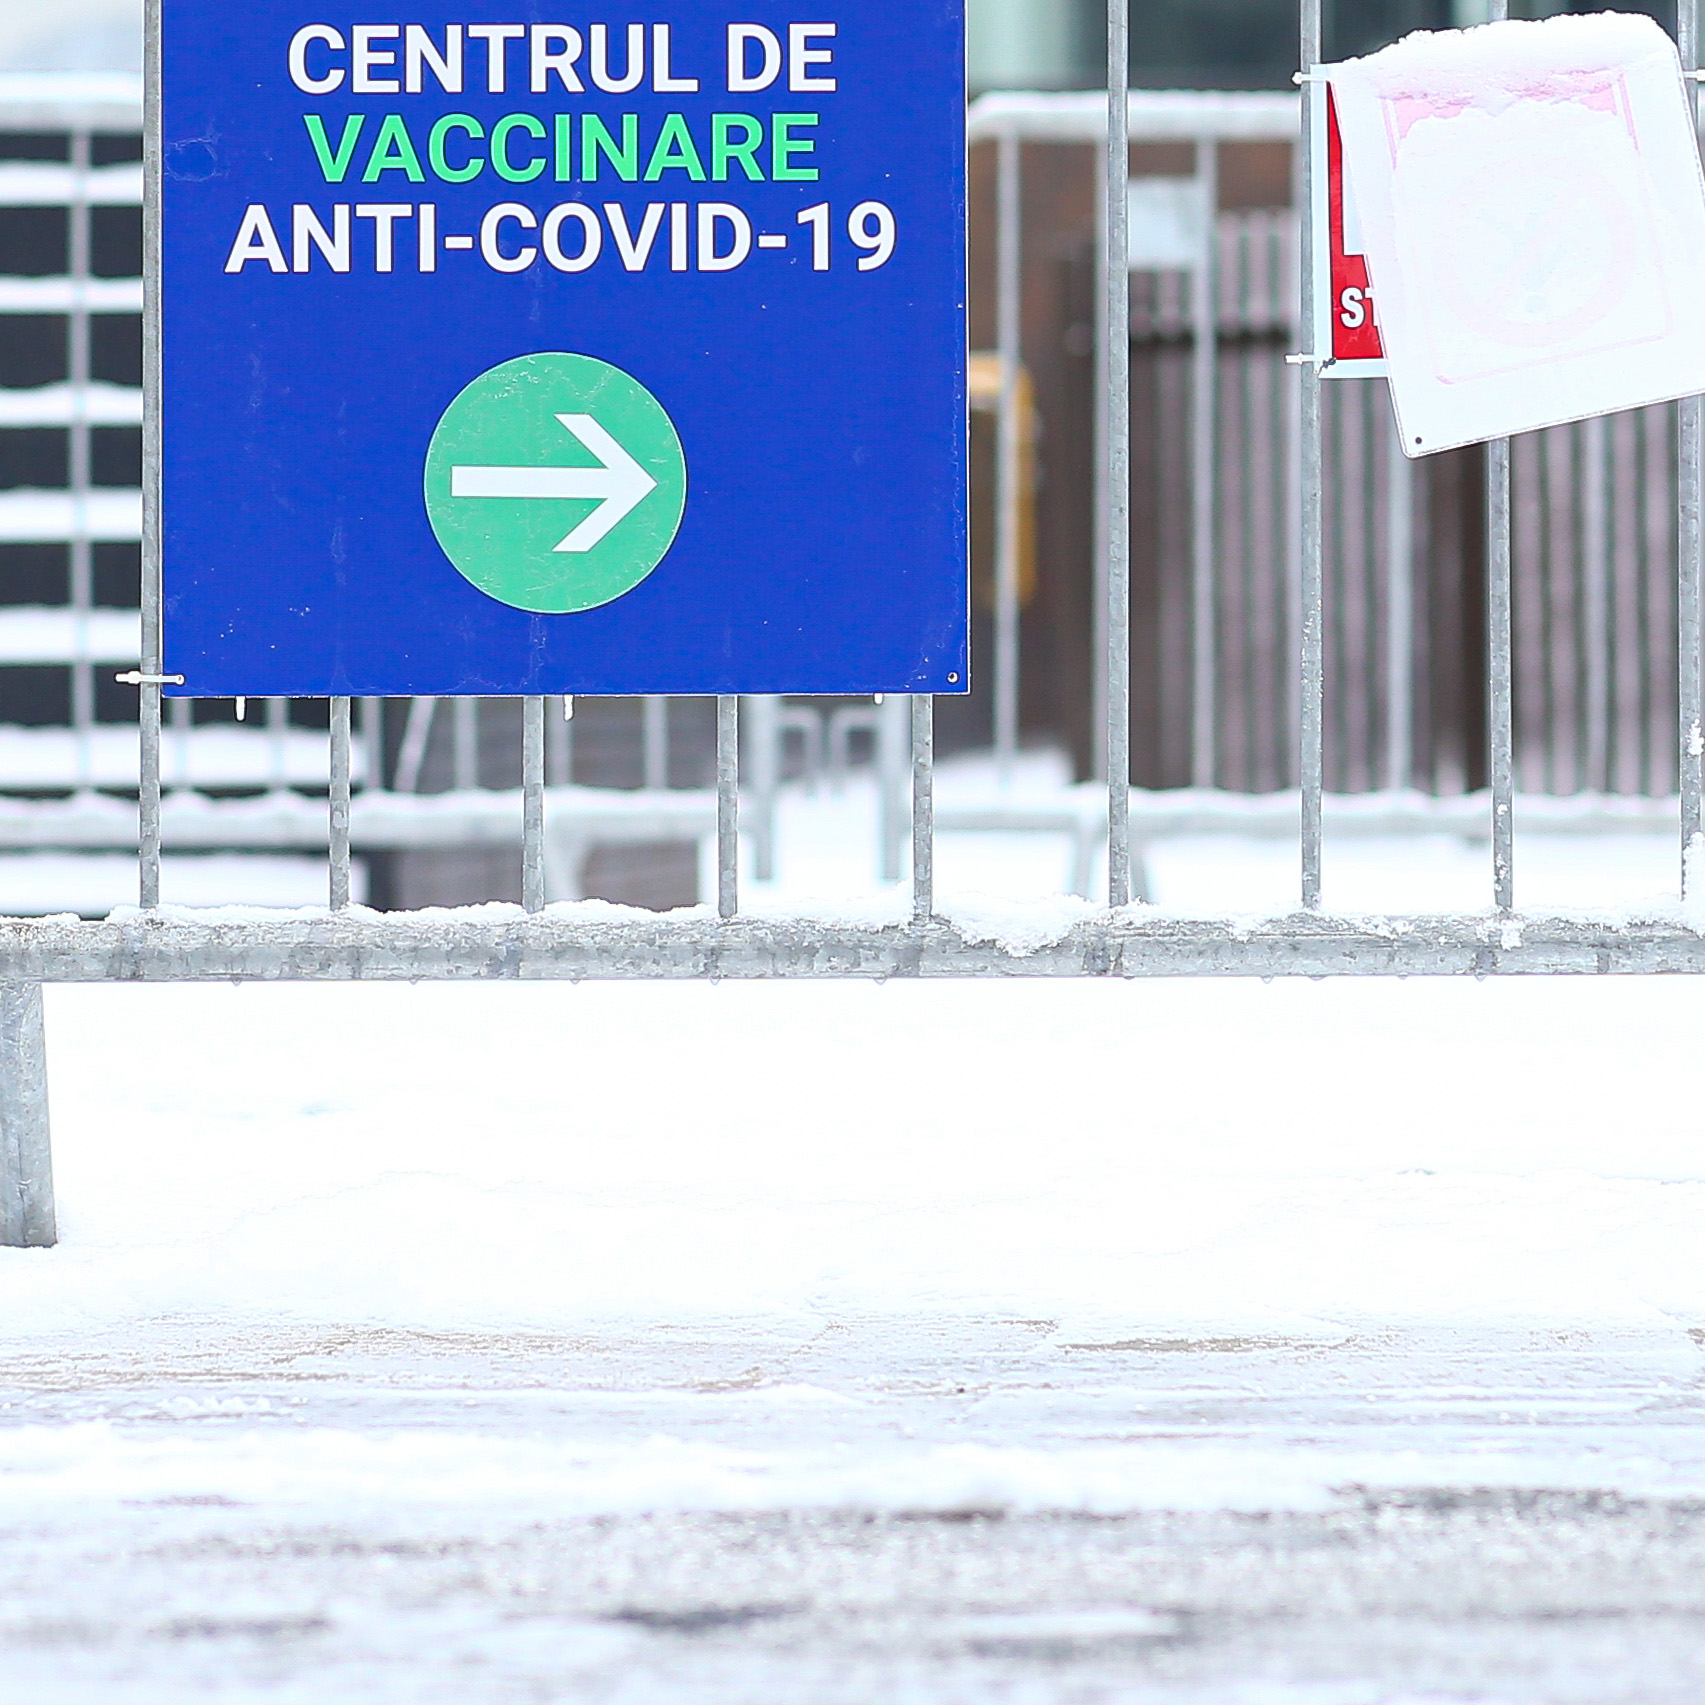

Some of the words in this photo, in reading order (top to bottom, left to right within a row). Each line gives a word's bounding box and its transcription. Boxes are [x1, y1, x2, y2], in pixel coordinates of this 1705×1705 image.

[288, 23, 699, 95] CENTRUL
[726, 23, 837, 94] DE
[303, 112, 820, 184] VACCINARE
[224, 201, 896, 274] ANTI-COVID-19
